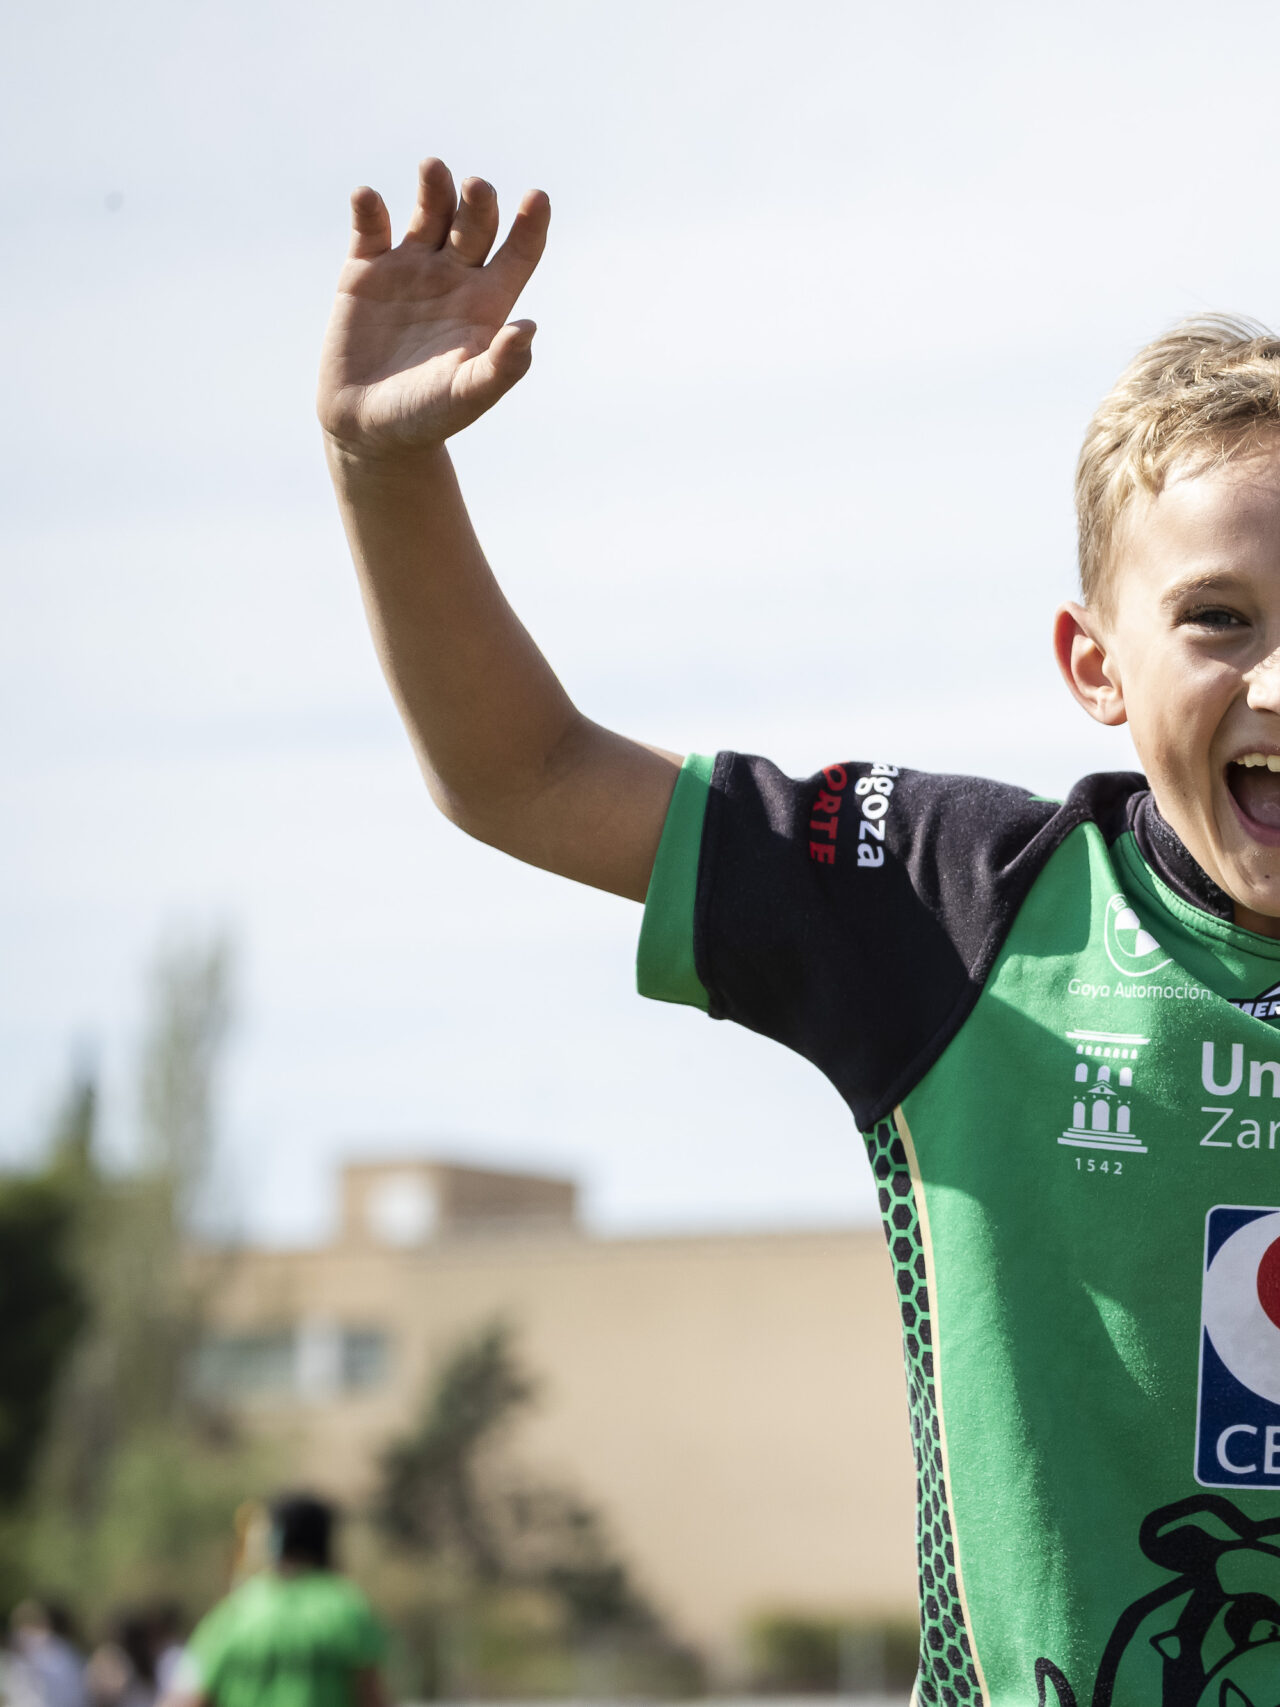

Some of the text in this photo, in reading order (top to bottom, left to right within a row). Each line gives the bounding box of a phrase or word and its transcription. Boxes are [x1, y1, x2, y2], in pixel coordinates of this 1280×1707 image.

[810, 760, 851, 865] ORTE
[1067, 978, 1212, 1001] Goya Automoción
